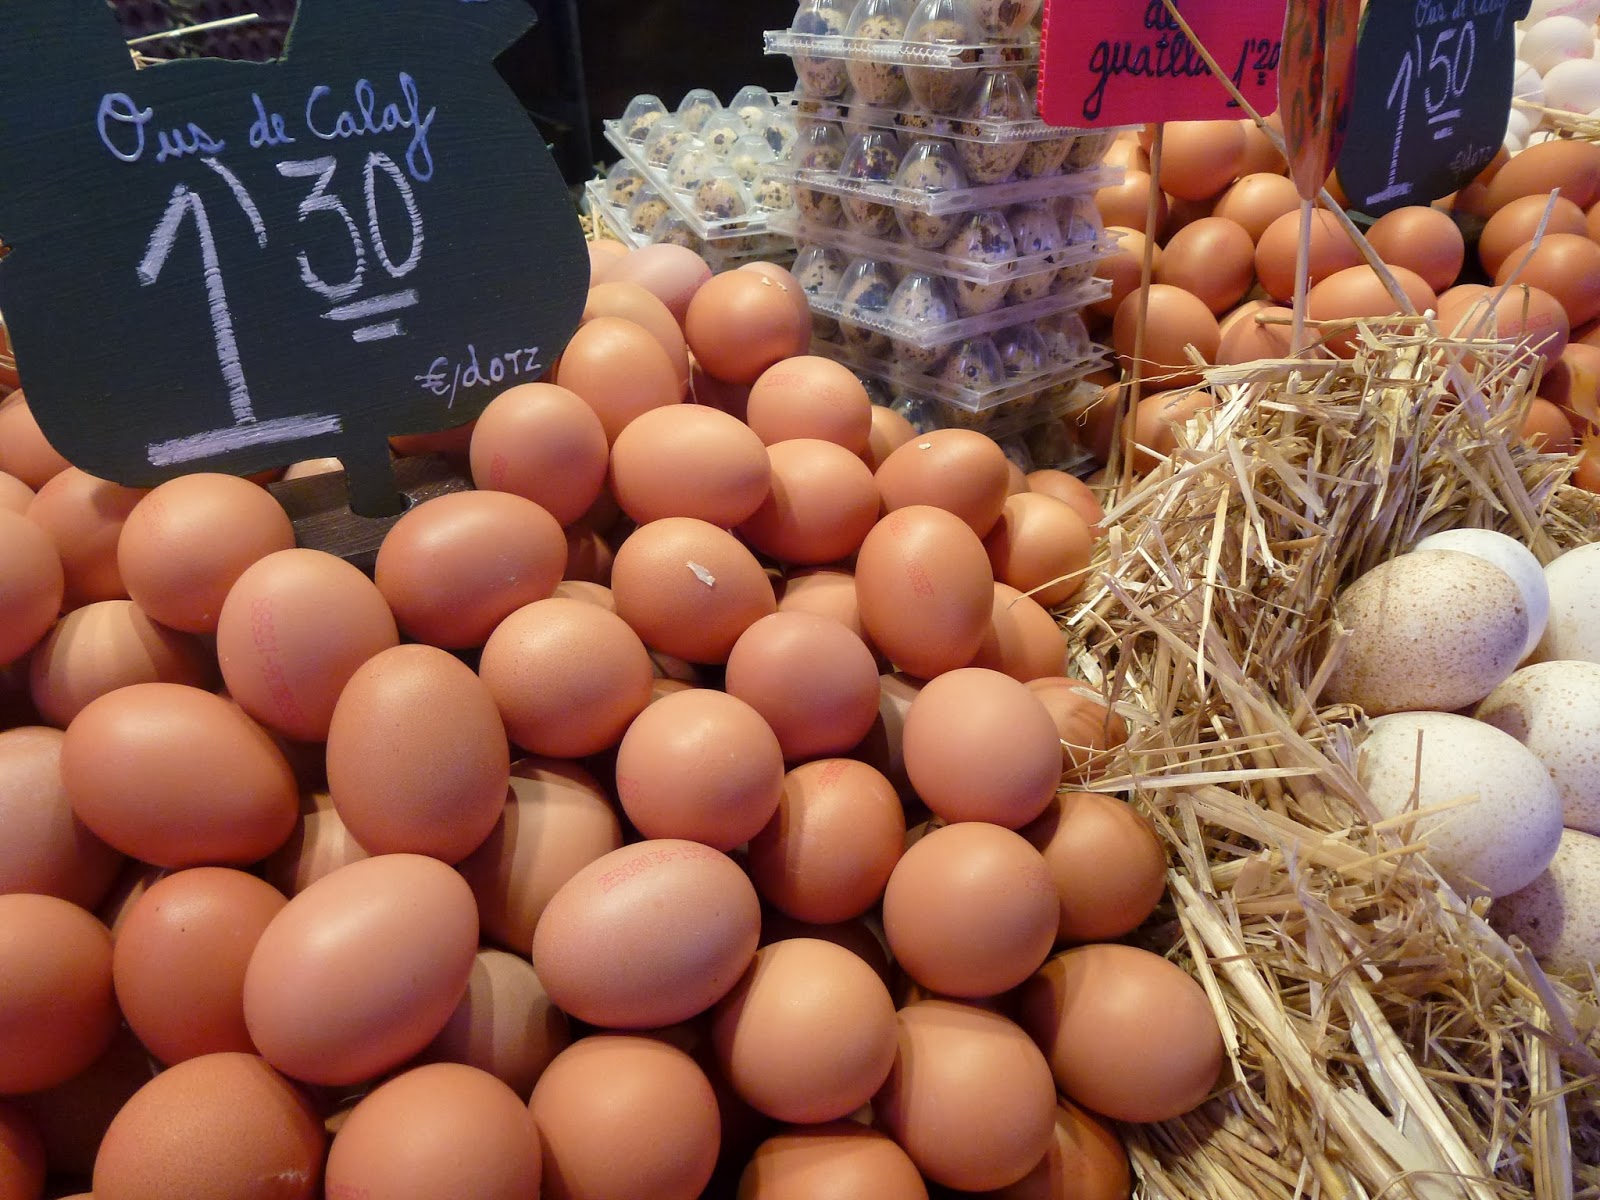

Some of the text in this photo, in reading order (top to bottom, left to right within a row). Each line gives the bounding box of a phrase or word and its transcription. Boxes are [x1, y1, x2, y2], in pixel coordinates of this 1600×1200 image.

[97, 72, 437, 182] Ous de Calaf
[1366, 20, 1476, 205] 1'50
[136, 152, 425, 467] 1'30
